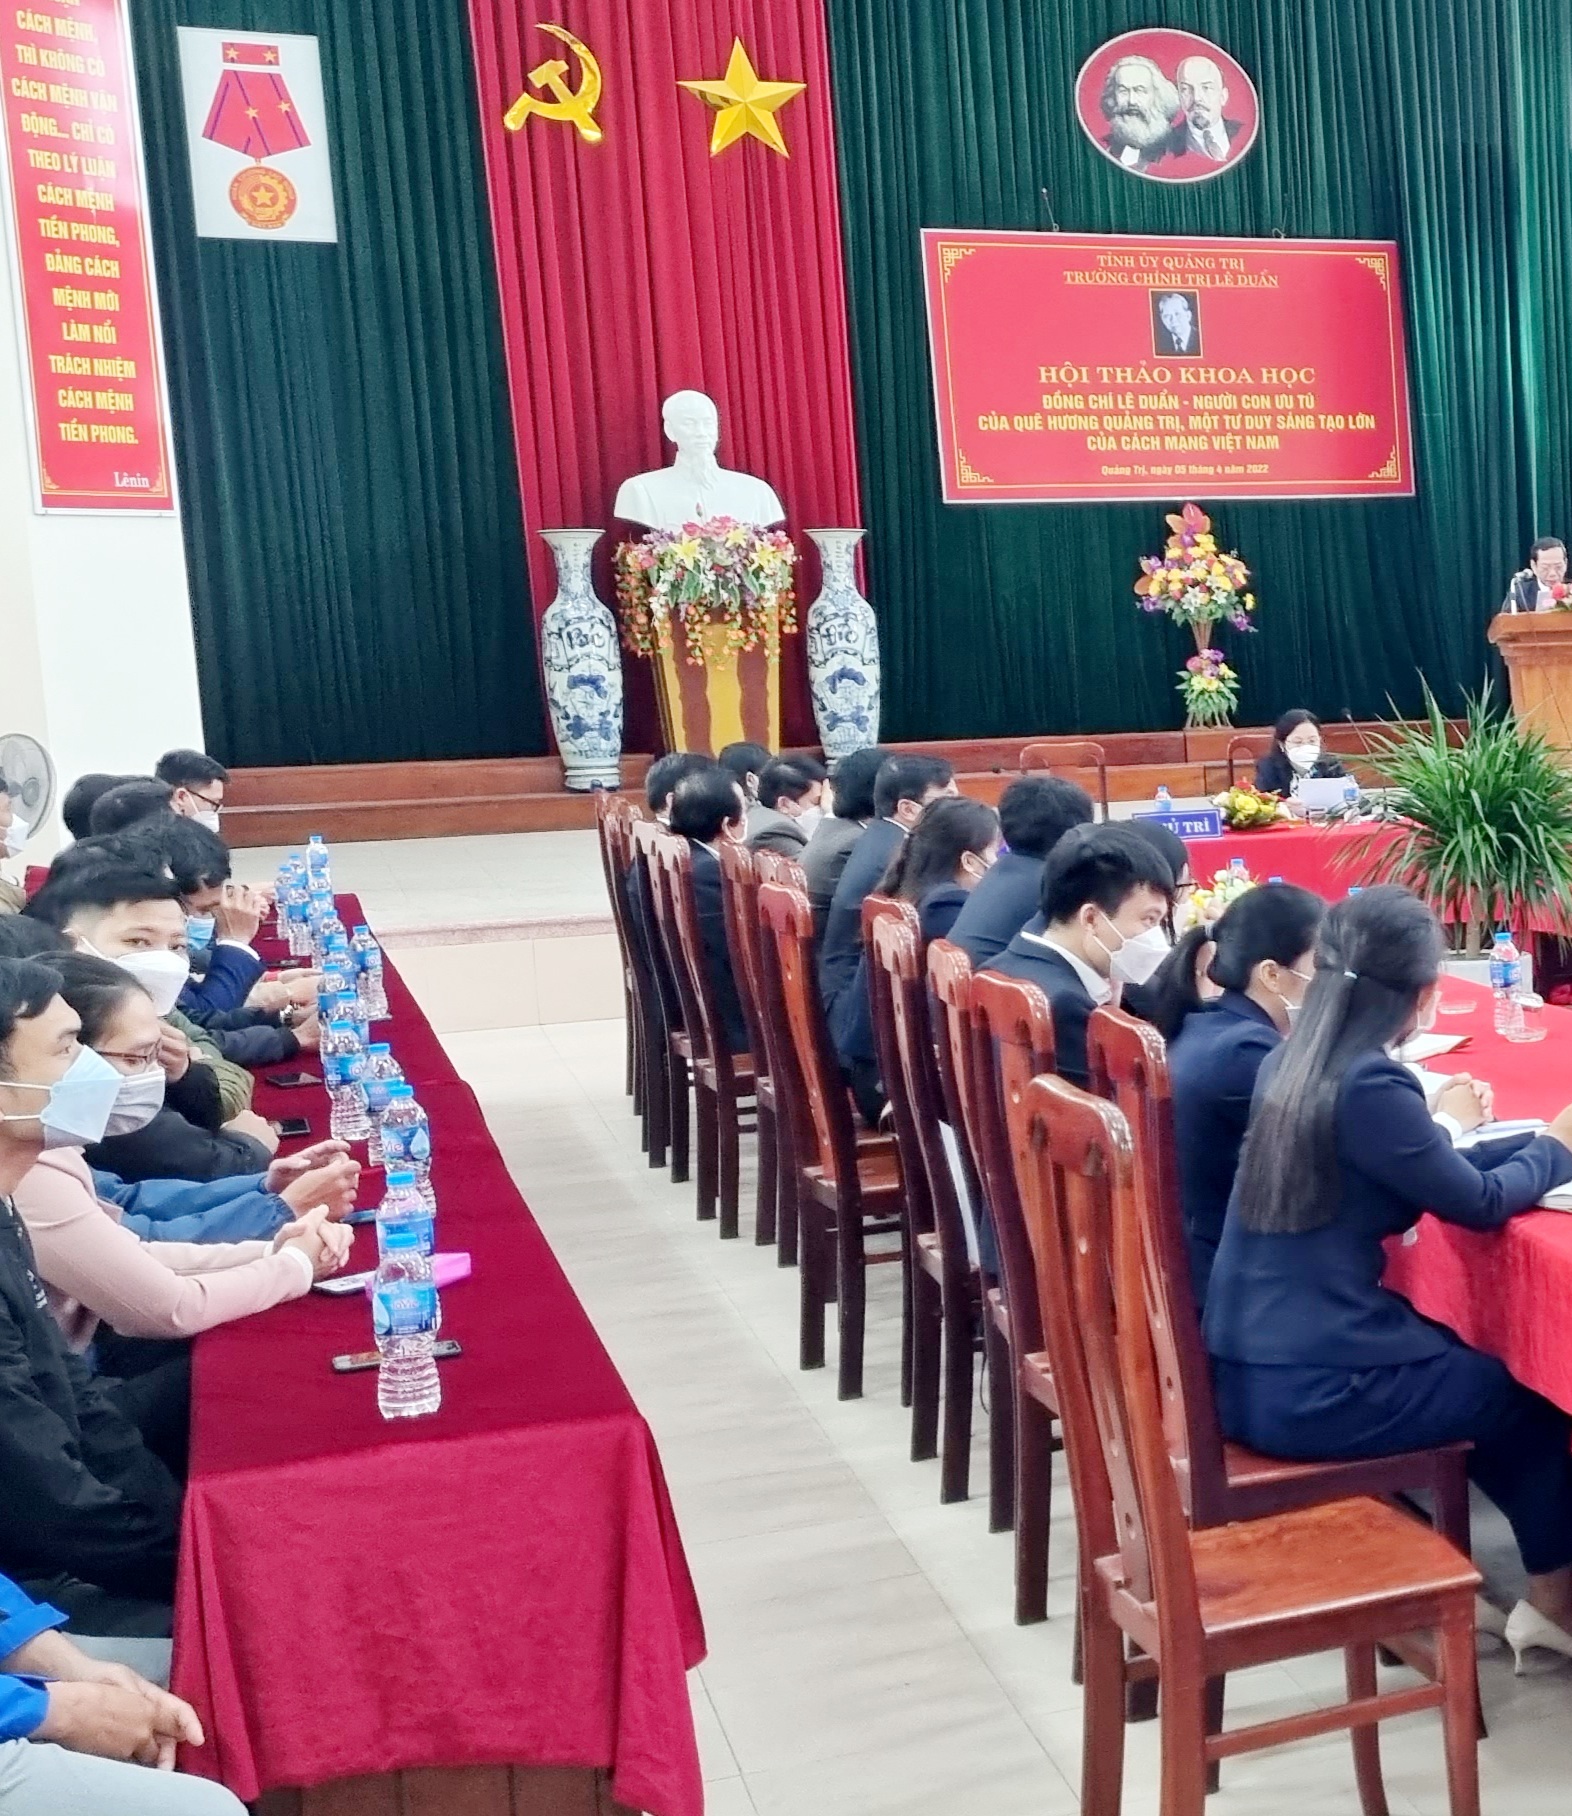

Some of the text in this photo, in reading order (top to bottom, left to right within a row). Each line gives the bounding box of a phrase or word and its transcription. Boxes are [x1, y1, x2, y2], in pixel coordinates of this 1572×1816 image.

[16, 8, 52, 34] CÁCH
[15, 43, 105, 77] THÌ KHÔNG CÓ
[11, 76, 117, 113] CÁCH MỆNH VẬN
[97, 123, 115, 145] CÓ
[27, 148, 115, 181] THEO LÝ LUẬN
[37, 183, 114, 214] CÁCH MỆNH
[71, 221, 120, 247] PHONG,
[45, 249, 120, 278] ĐẢNG CÁCH
[1096, 251, 1245, 272] TỈNH ỦY QUẢNG TRỊ
[1063, 268, 1279, 288] TRƯỜNG CHÍNH TRỊ LÊ DUẨN
[52, 285, 120, 311] MỆNH MỚI
[62, 319, 90, 342] LÀM
[48, 353, 136, 382] TRÁCH NHIỆM
[1039, 360, 1316, 388] HỘI THẢO KHOA HỌC
[58, 387, 133, 414] CÁCH MỆNH
[1042, 390, 1085, 410] ĐỒNG
[1088, 391, 1114, 409] CHÍ
[1118, 391, 1134, 409] LÊ
[1139, 389, 1179, 410] DUẨN
[1193, 391, 1237, 410] NGƯỜI
[1241, 394, 1271, 410] CON
[1275, 392, 1295, 410] ƯU
[1297, 391, 1315, 409] TÚ
[978, 411, 1010, 431] CỦA
[1013, 412, 1043, 432] QUÊ
[1047, 414, 1099, 431] HƯƠNG
[1103, 410, 1153, 432] QUẢNG
[1188, 411, 1219, 433] MỘT
[1223, 413, 1242, 430] TƯ
[1245, 414, 1272, 430] DUY
[1276, 411, 1315, 430] SÁNG
[1318, 414, 1345, 432] TẠO
[1348, 411, 1376, 430] LỚN
[91, 424, 139, 444] PHONG.
[1087, 431, 1280, 453] CỦA CÁCH MẠNG VIỆT NAM
[114, 471, 150, 488] Lênin
[1101, 464, 1131, 476] Quảng
[1151, 465, 1172, 475] ngày
[1174, 465, 1186, 474] 05
[1188, 464, 1214, 475] tháng
[1216, 465, 1222, 474] 4
[1224, 464, 1245, 474] năm
[1246, 464, 1269, 474] 2022
[1182, 816, 1211, 833] TRÌ
